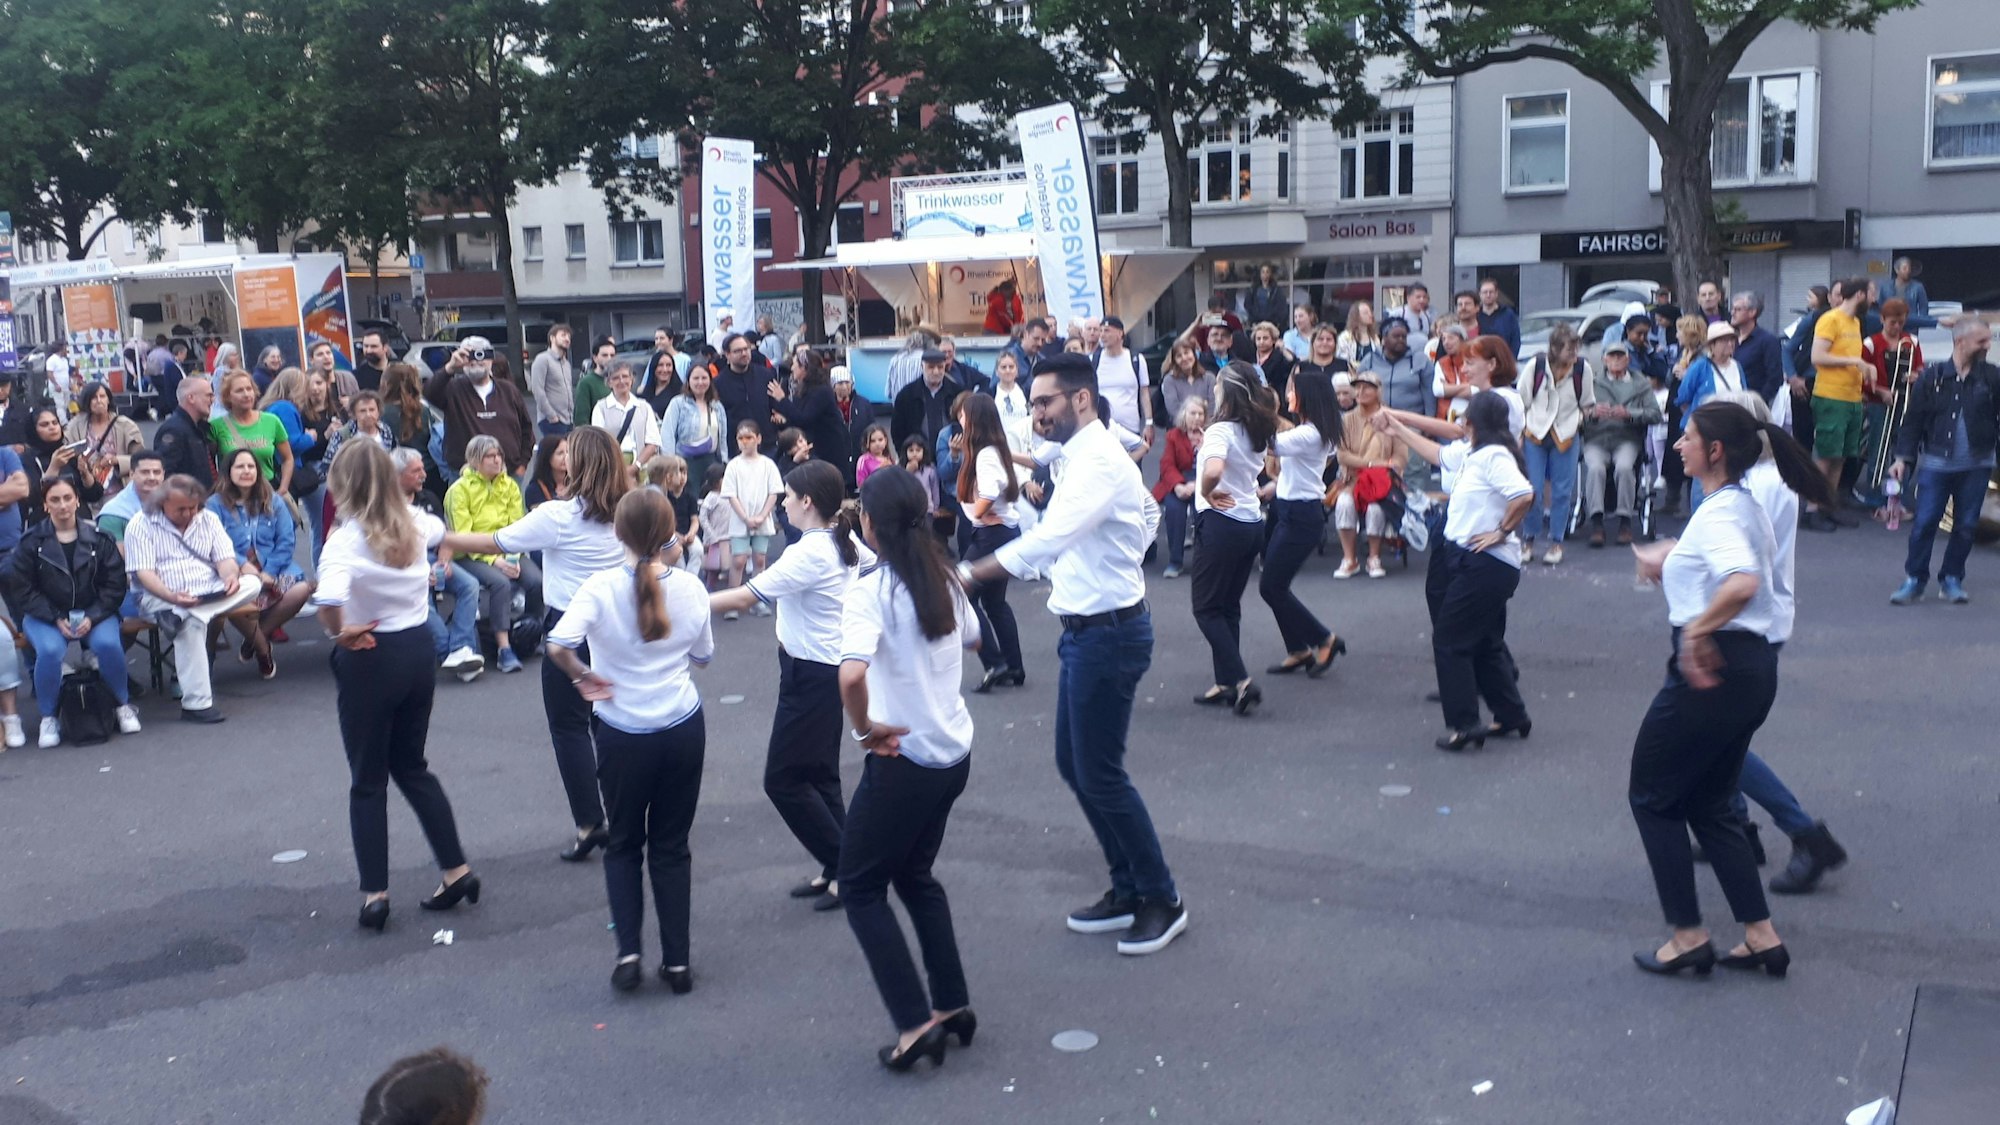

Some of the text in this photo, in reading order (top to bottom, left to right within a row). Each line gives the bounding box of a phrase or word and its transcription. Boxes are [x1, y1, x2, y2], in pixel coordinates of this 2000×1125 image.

[915, 191, 1004, 209] Trinkwasser
[736, 186, 747, 248] kostenlos
[1329, 220, 1415, 239] Salon Bas
[711, 185, 732, 308] kwasser
[1578, 232, 1670, 253] FAHRSCH
